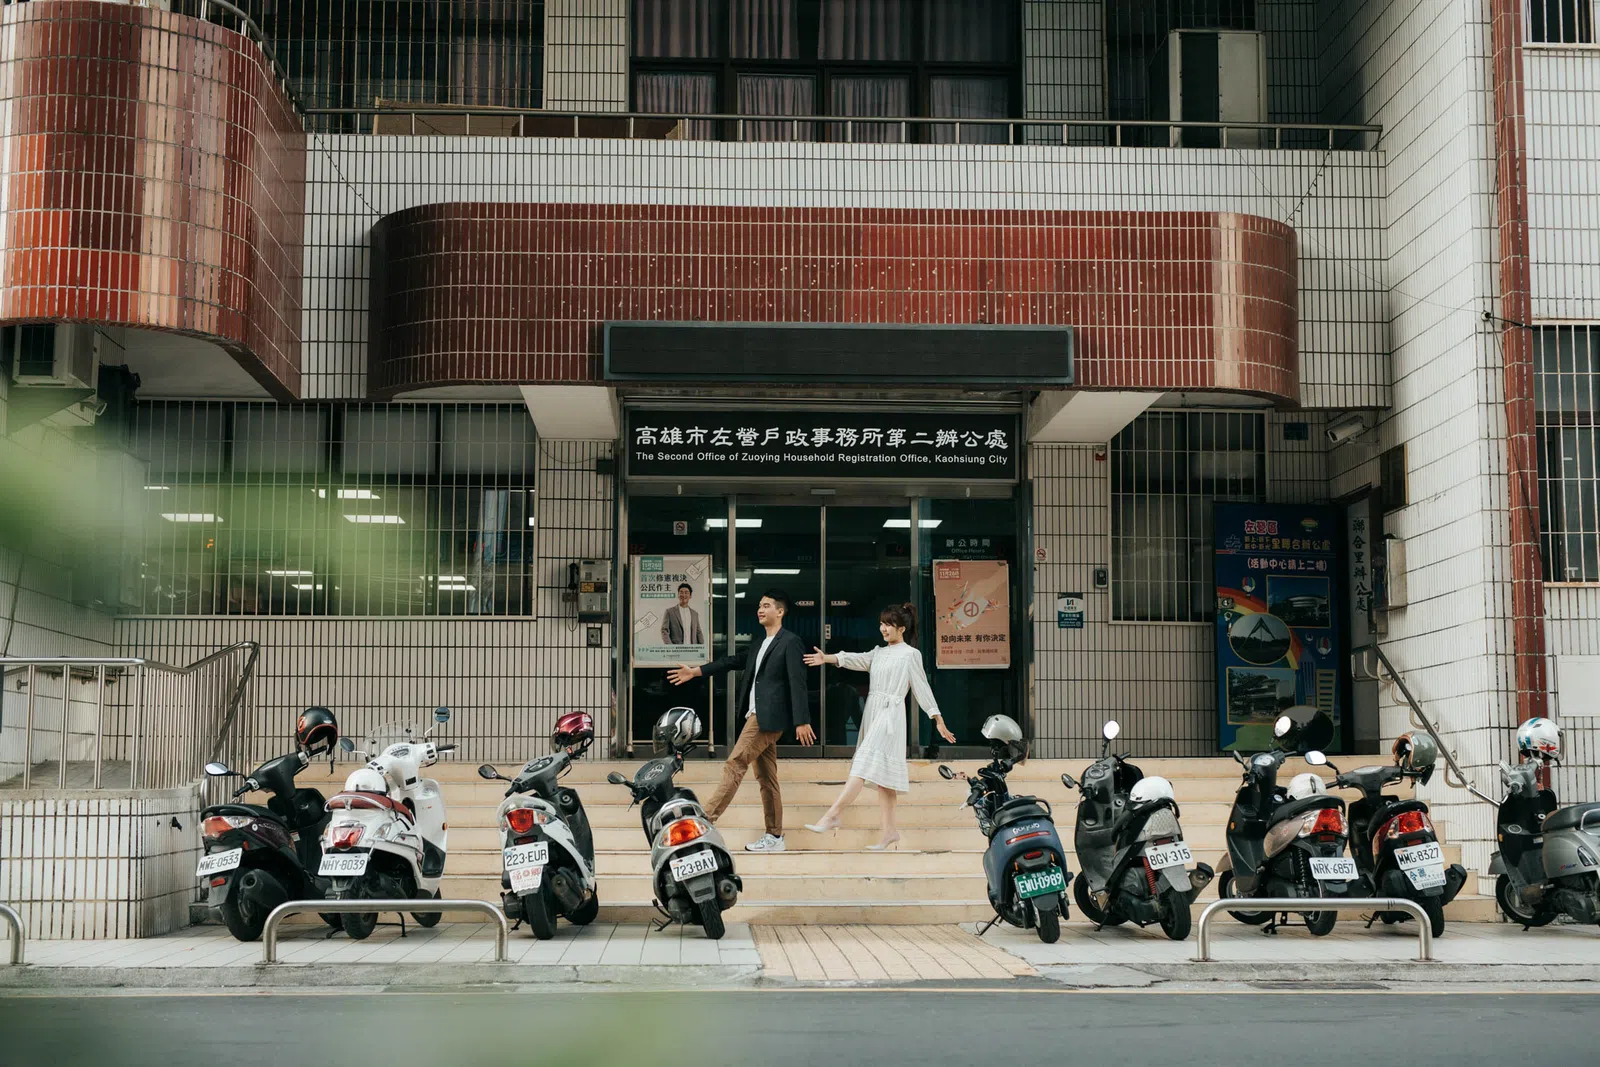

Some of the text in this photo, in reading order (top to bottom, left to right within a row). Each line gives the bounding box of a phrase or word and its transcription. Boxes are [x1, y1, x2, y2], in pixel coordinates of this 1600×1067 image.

[635, 426, 1009, 449] 高雄市左營戶政事務所第二辦公處
[635, 452, 1008, 465] The Second Office of Zuoying Household Registration Office, Kaohsiung City
[640, 583, 672, 592] 公民作主
[941, 635, 972, 643] 投向未來
